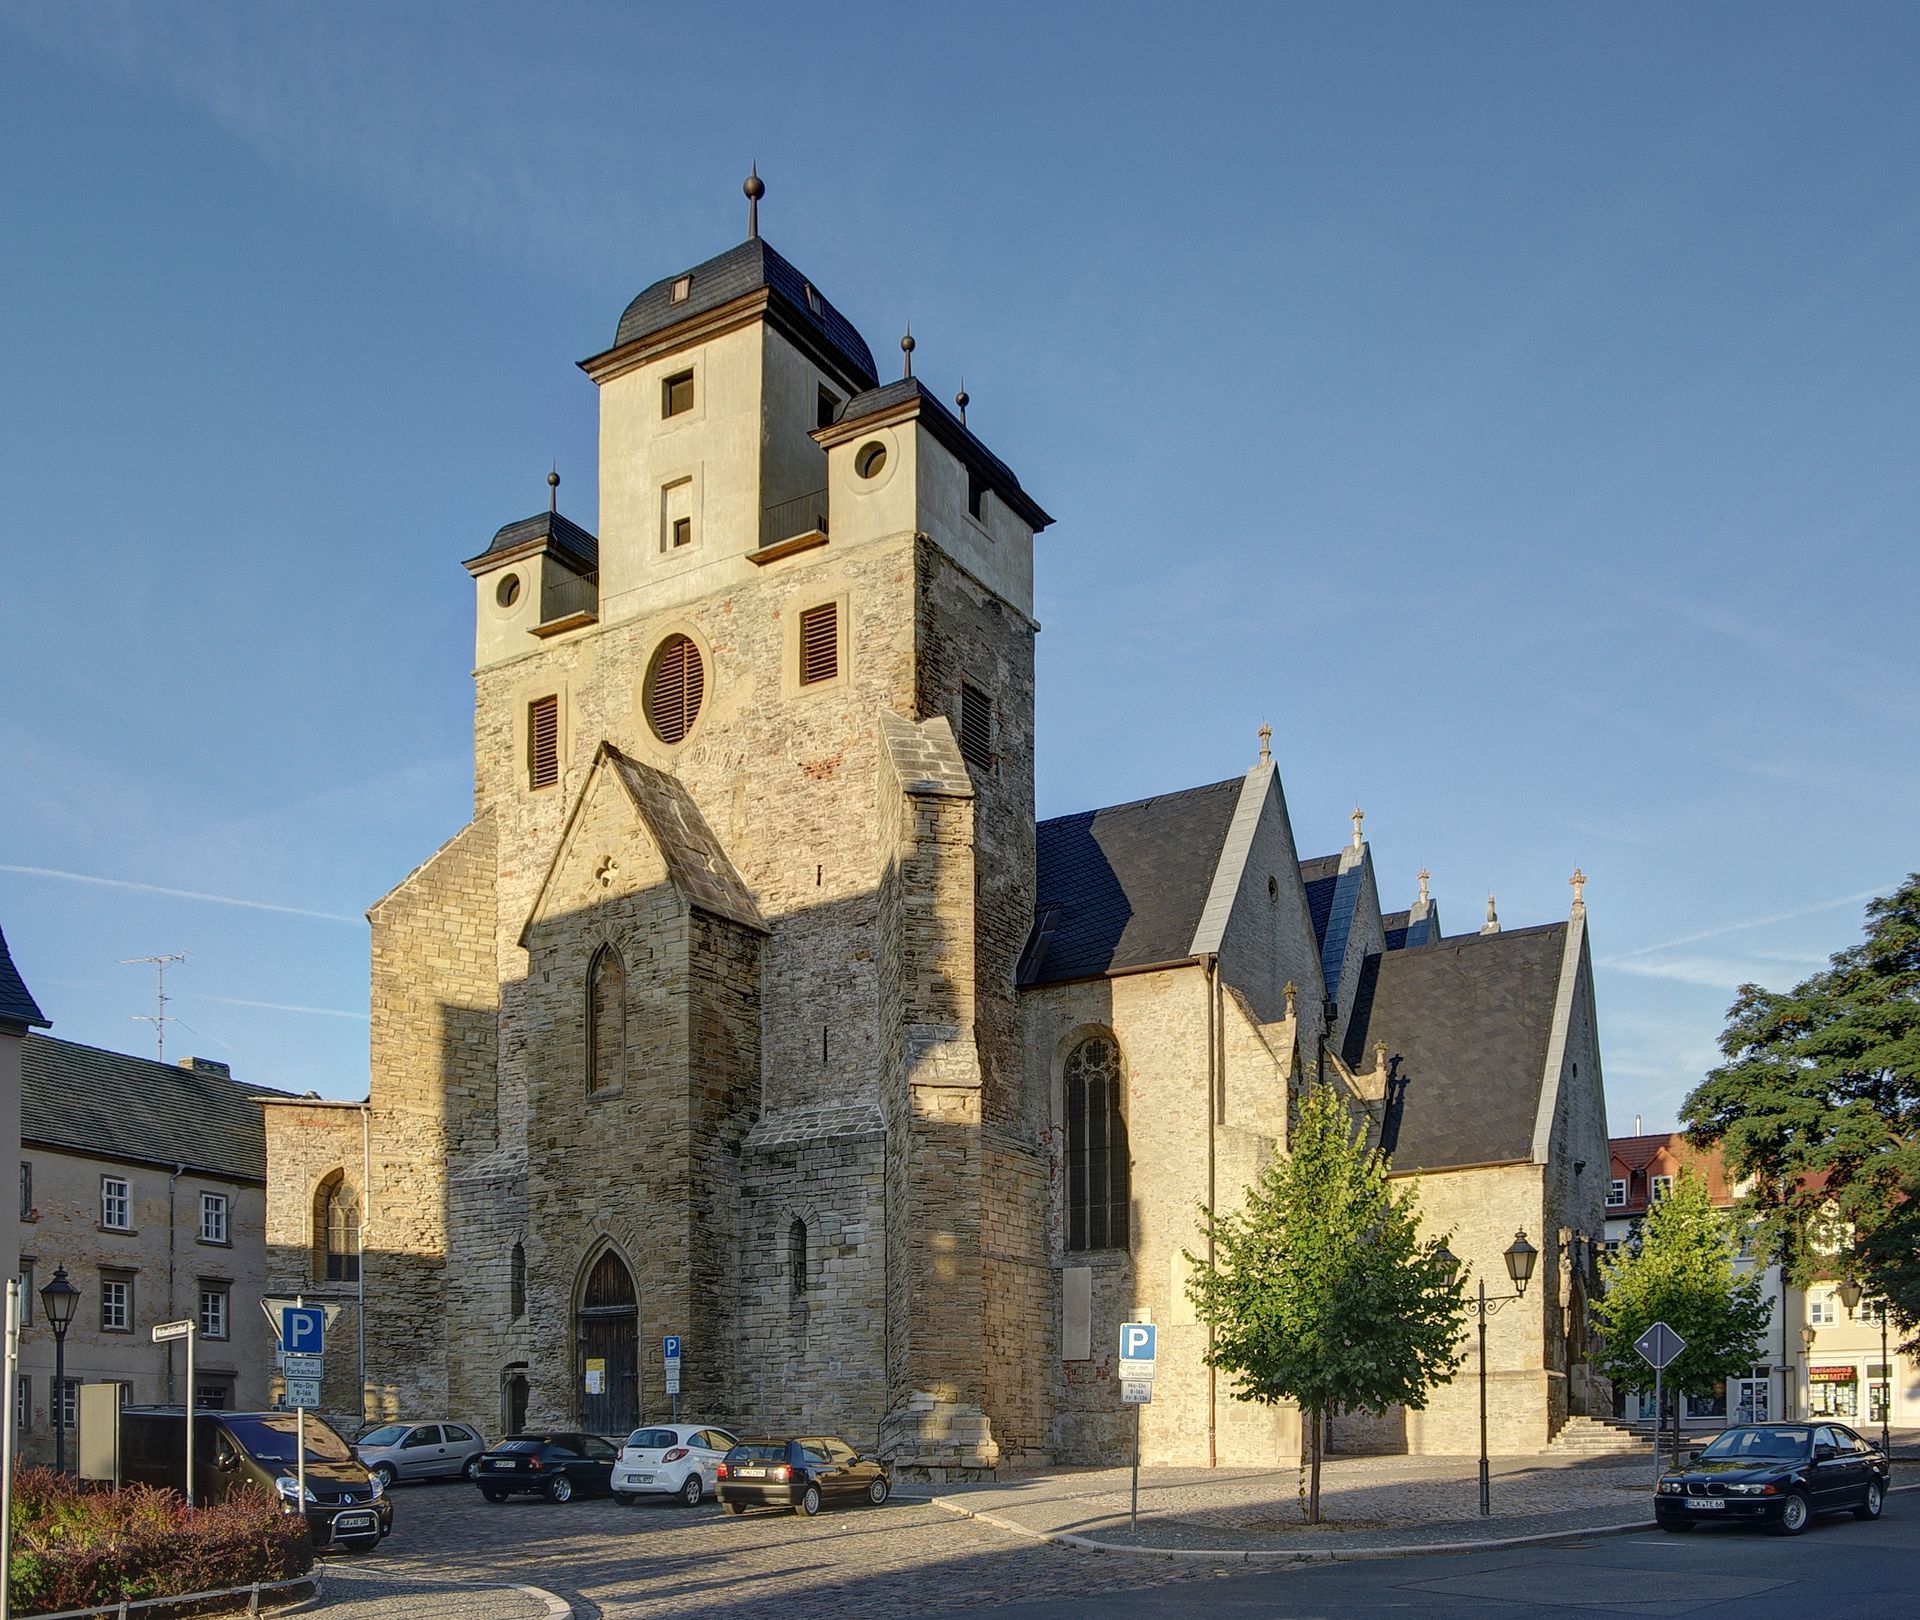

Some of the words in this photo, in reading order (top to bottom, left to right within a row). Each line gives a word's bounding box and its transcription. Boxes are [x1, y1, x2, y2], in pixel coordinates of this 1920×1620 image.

[291, 1313, 314, 1348] P
[667, 1339, 677, 1356] P
[1128, 1328, 1149, 1357] P
[286, 1367, 320, 1375] Parkschein
[1809, 1373, 1829, 1381] TAXI
